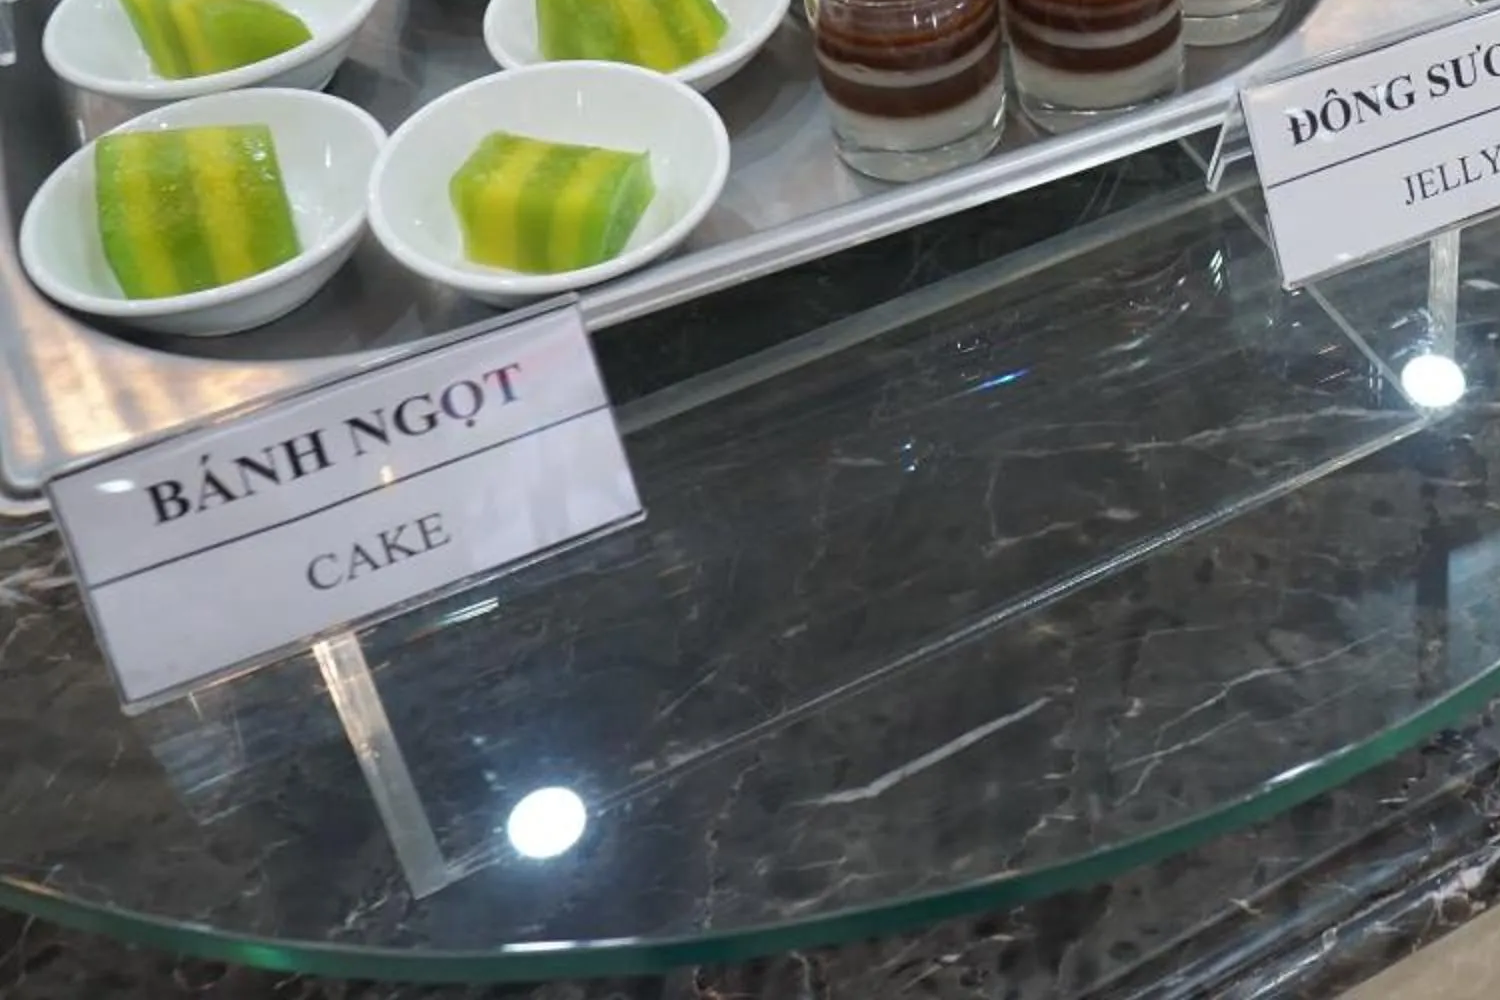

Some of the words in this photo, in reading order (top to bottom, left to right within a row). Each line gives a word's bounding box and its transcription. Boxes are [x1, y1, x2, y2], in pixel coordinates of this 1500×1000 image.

[1289, 73, 1416, 147] ĐÔNG
[145, 428, 335, 526] BÁNH
[343, 362, 523, 458] NGỌT
[306, 511, 452, 591] CAKE
